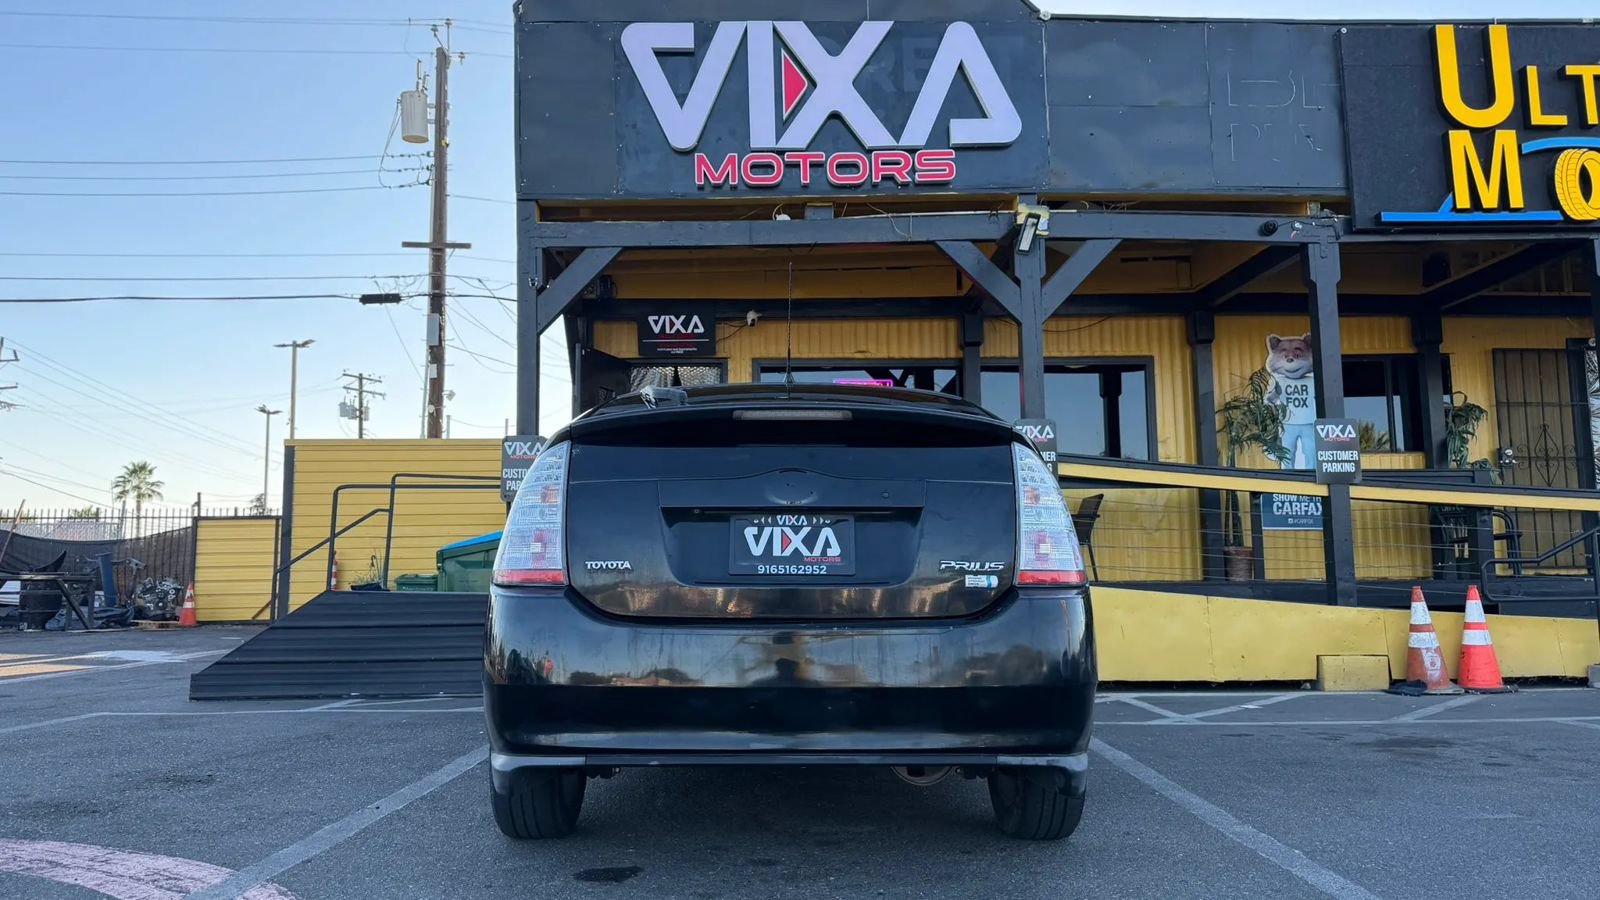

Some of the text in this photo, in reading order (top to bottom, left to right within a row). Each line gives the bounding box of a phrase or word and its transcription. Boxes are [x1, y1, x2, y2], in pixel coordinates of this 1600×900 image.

[620, 20, 1023, 152] VIXA
[694, 150, 957, 189] MOTORS
[647, 314, 705, 334] VIXA
[1285, 384, 1309, 396] CAR
[1286, 397, 1309, 408] FOX
[1316, 424, 1357, 438] VIXA
[1317, 450, 1359, 461] CUSTOMER
[1322, 462, 1356, 473] PARKING
[502, 468, 529, 479] CUSTO
[1272, 493, 1298, 502] SHOW
[776, 514, 808, 526] VIXA
[743, 526, 842, 557] VIXA
[585, 560, 632, 570] TOYOTA
[757, 564, 828, 575] 9165162952
[939, 560, 1005, 571] PRIUS
